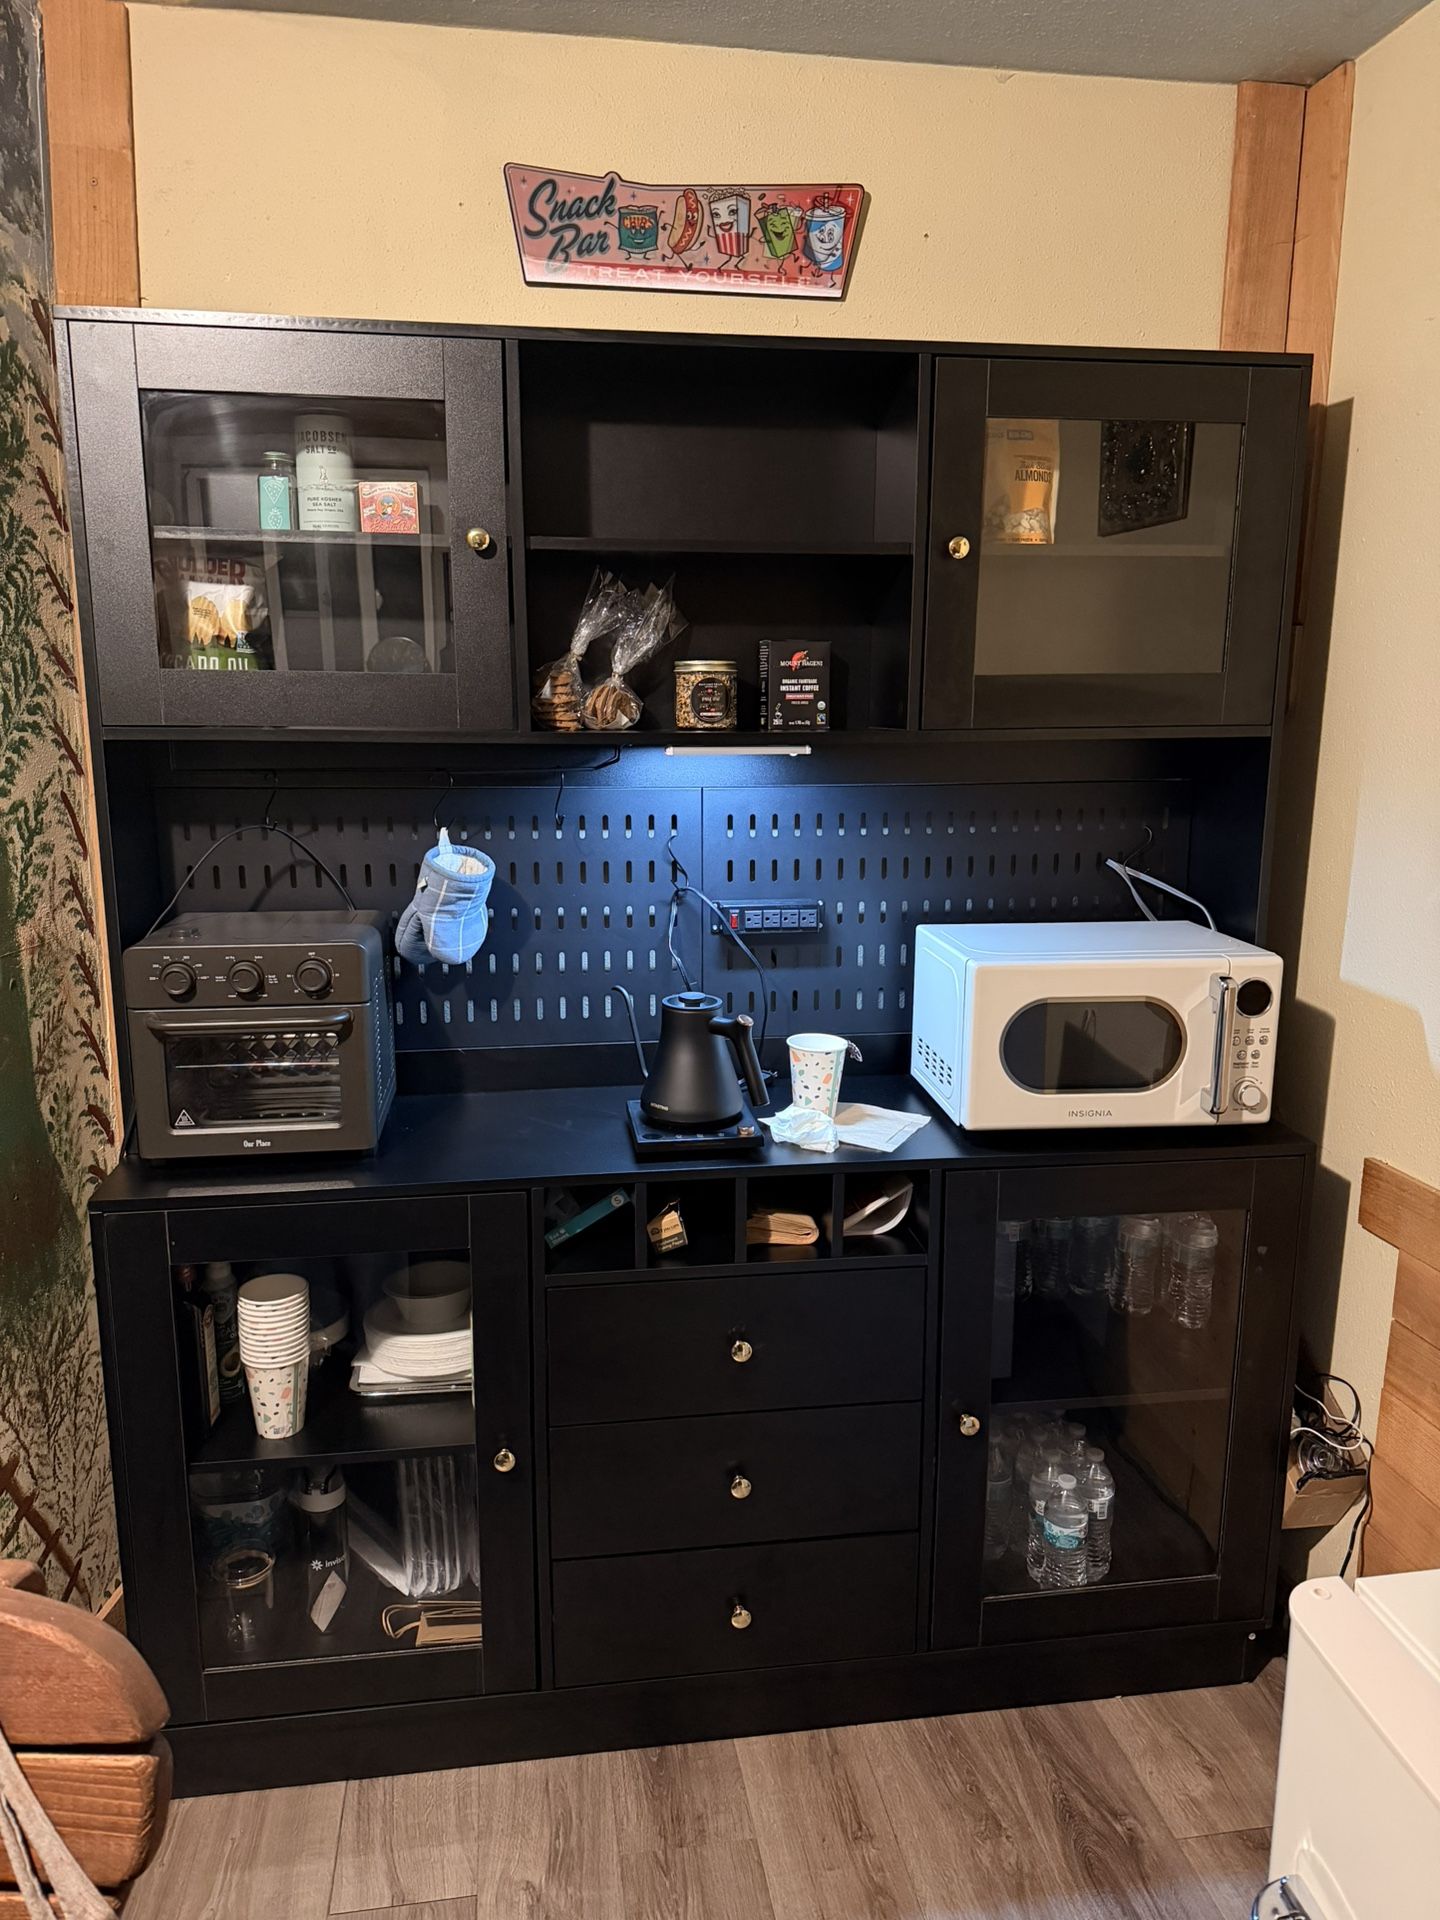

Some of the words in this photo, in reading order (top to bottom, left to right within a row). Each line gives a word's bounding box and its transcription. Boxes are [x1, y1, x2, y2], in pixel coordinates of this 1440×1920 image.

[523, 177, 616, 237] Snack
[548, 223, 610, 270] Bar
[583, 265, 665, 281] TREAT
[679, 270, 811, 287] YOURSELF
[297, 430, 349, 444] JACOBSEN
[305, 445, 325, 455] SALT
[780, 684, 801, 692] INSTANT
[802, 684, 819, 692] COFFEE
[1068, 1109, 1113, 1118] INSIGNIA
[243, 1139, 254, 1148] Our
[255, 1139, 271, 1148] Place
